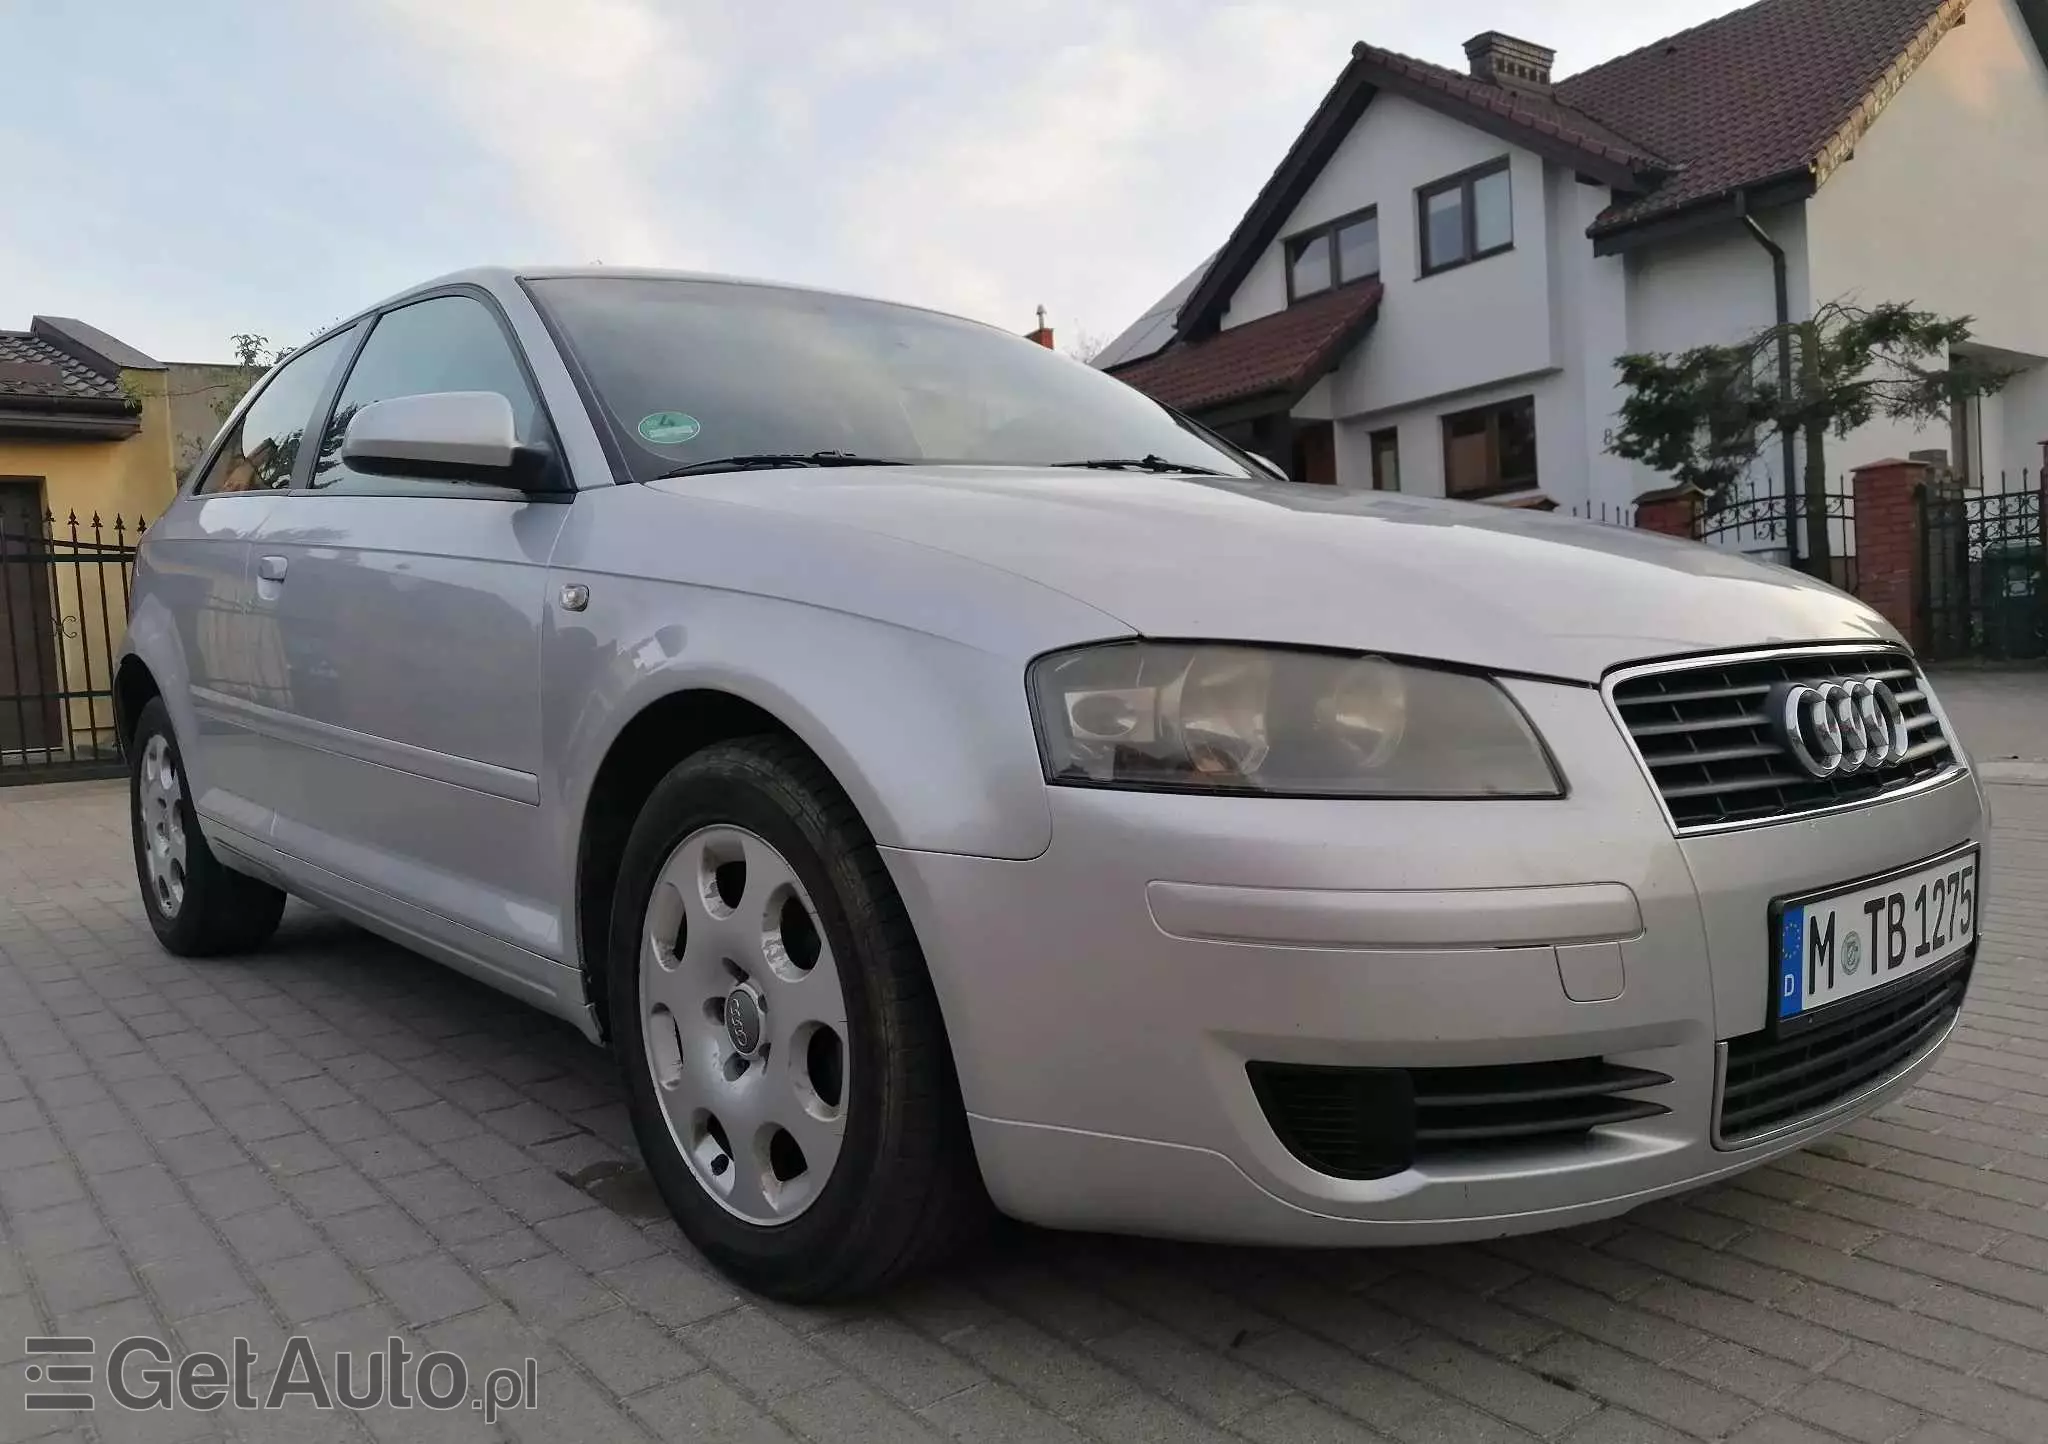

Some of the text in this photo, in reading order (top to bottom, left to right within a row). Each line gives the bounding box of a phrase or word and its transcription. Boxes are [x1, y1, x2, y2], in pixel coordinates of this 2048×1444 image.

[1808, 865, 1973, 995] M TB 1275
[1784, 973, 1795, 997] D
